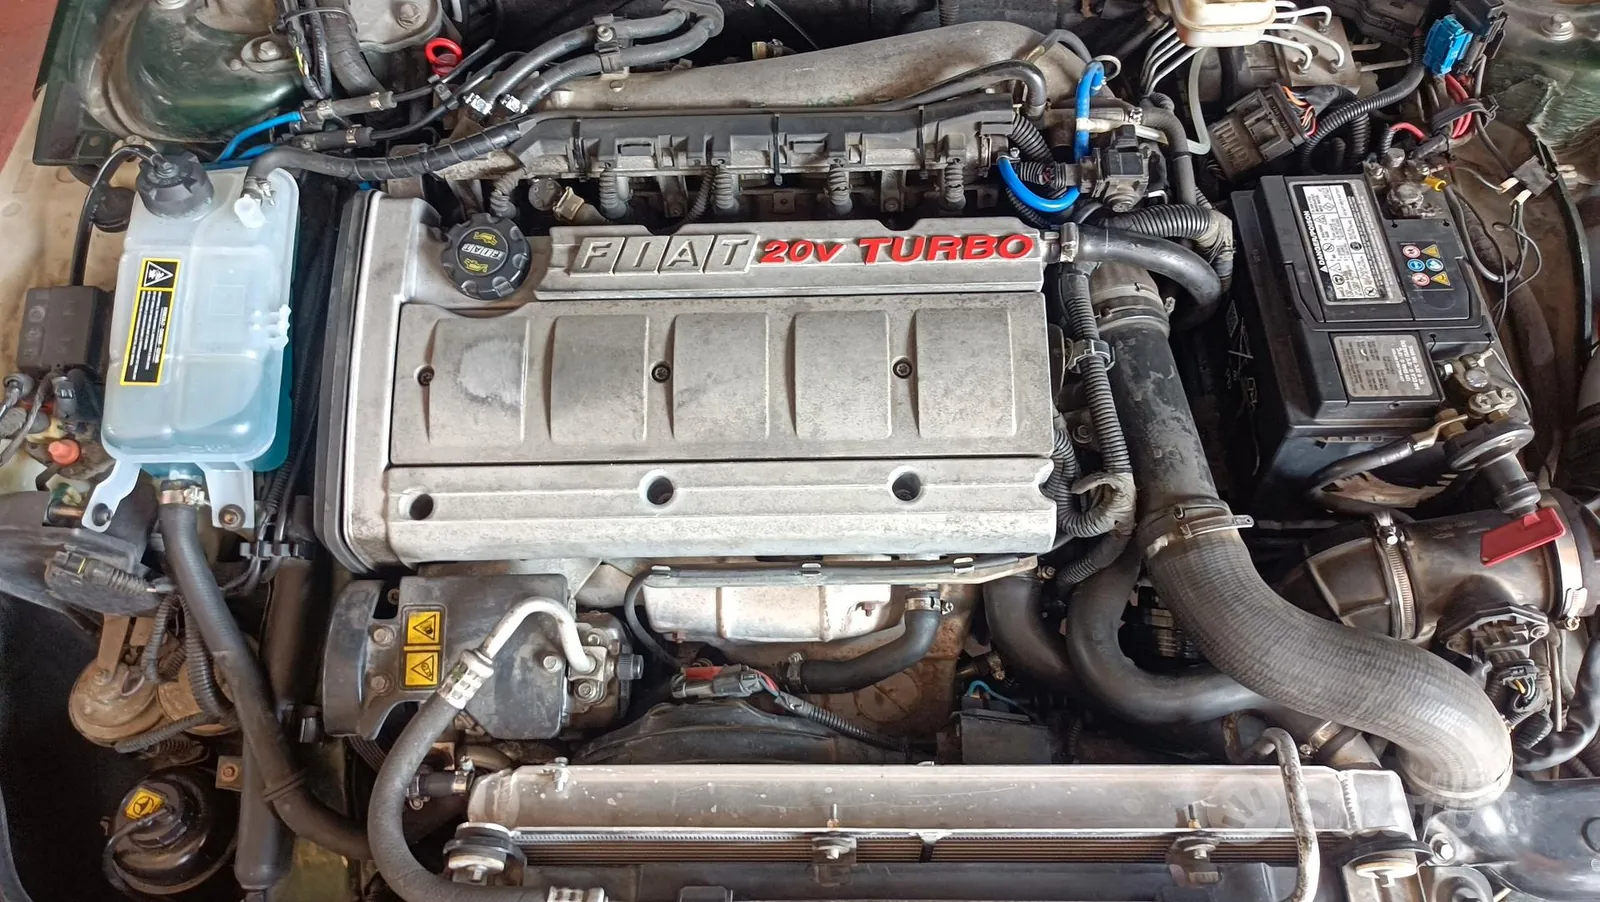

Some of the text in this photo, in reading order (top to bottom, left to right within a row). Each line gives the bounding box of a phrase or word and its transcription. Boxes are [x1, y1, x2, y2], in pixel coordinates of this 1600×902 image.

[461, 243, 503, 260] FIAT
[580, 237, 752, 270] FIAT
[858, 234, 1034, 265] TURBO
[1303, 210, 1325, 266] DANGER/POISON
